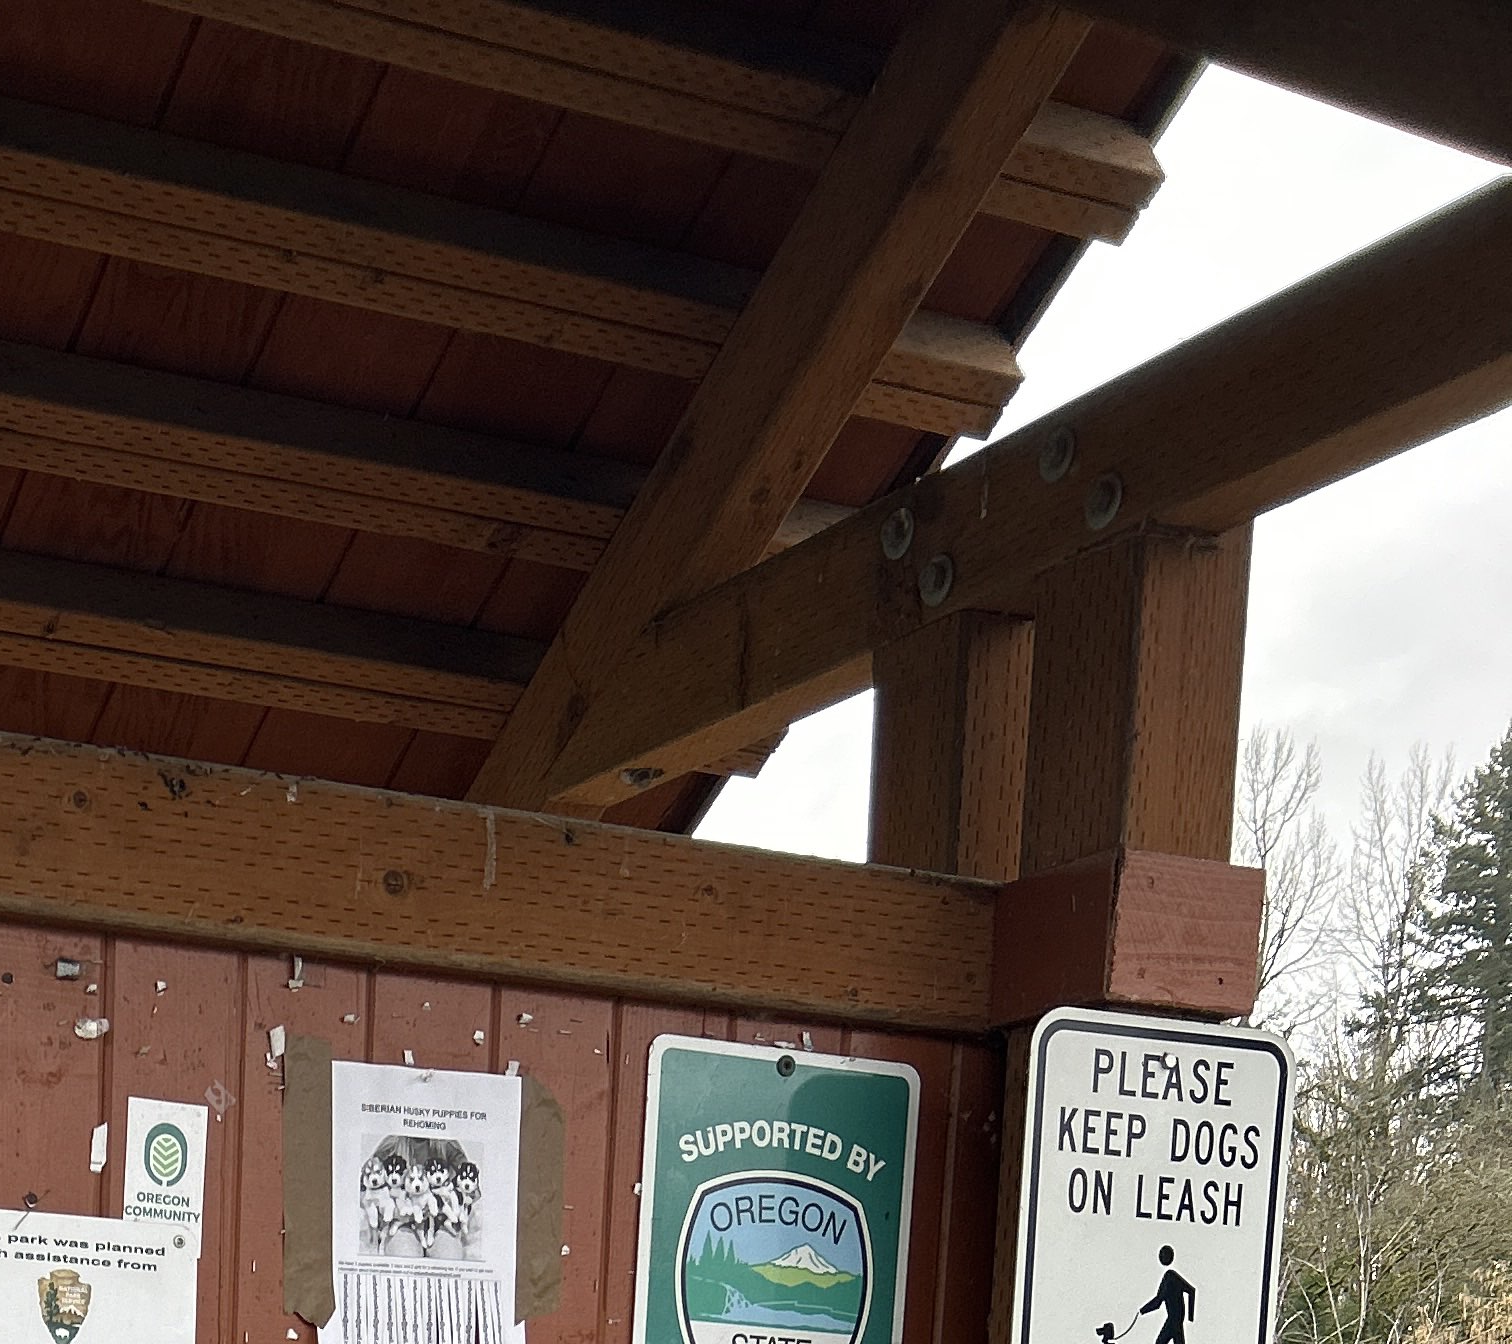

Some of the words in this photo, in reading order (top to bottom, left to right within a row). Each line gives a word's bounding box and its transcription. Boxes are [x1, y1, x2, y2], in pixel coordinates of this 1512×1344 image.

[1092, 1048, 1234, 1106] PLEASE
[679, 1120, 842, 1162] SUPPORTED
[846, 1144, 886, 1181] BY
[1058, 1106, 1146, 1157] KEEP
[1170, 1118, 1260, 1169] DOGS
[124, 1205, 201, 1224] COMMUNITY
[136, 1192, 190, 1208] OREGON
[710, 1194, 847, 1245] OREGON
[1068, 1167, 1113, 1215] ON
[1136, 1174, 1242, 1226] LEASH
[8, 1235, 47, 1245] park
[53, 1238, 88, 1248] was
[96, 1241, 165, 1256] planned
[14, 1252, 110, 1266] assistance
[117, 1259, 156, 1271] from
